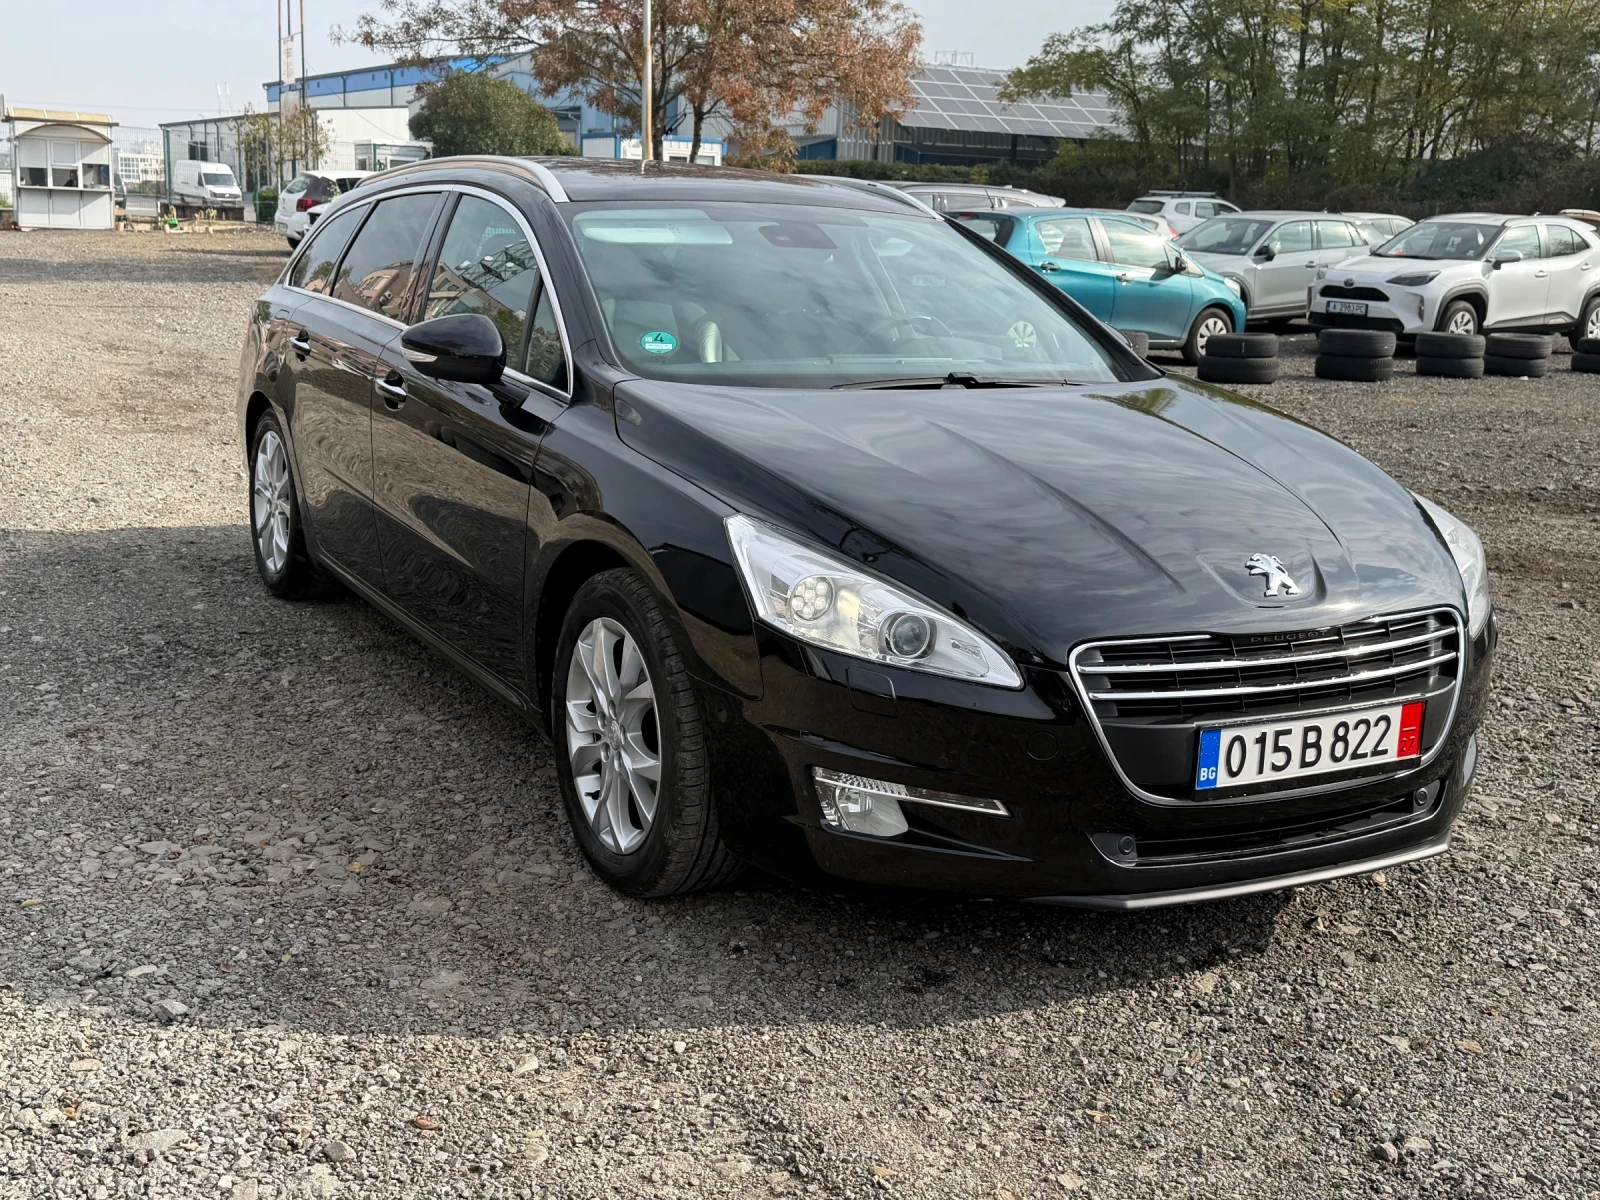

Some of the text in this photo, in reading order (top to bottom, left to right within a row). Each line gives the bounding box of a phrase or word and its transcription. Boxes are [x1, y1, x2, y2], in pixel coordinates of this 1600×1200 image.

[653, 332, 665, 343] 4
[1250, 629, 1328, 643] PEUGEOT
[1199, 766, 1217, 781] BG
